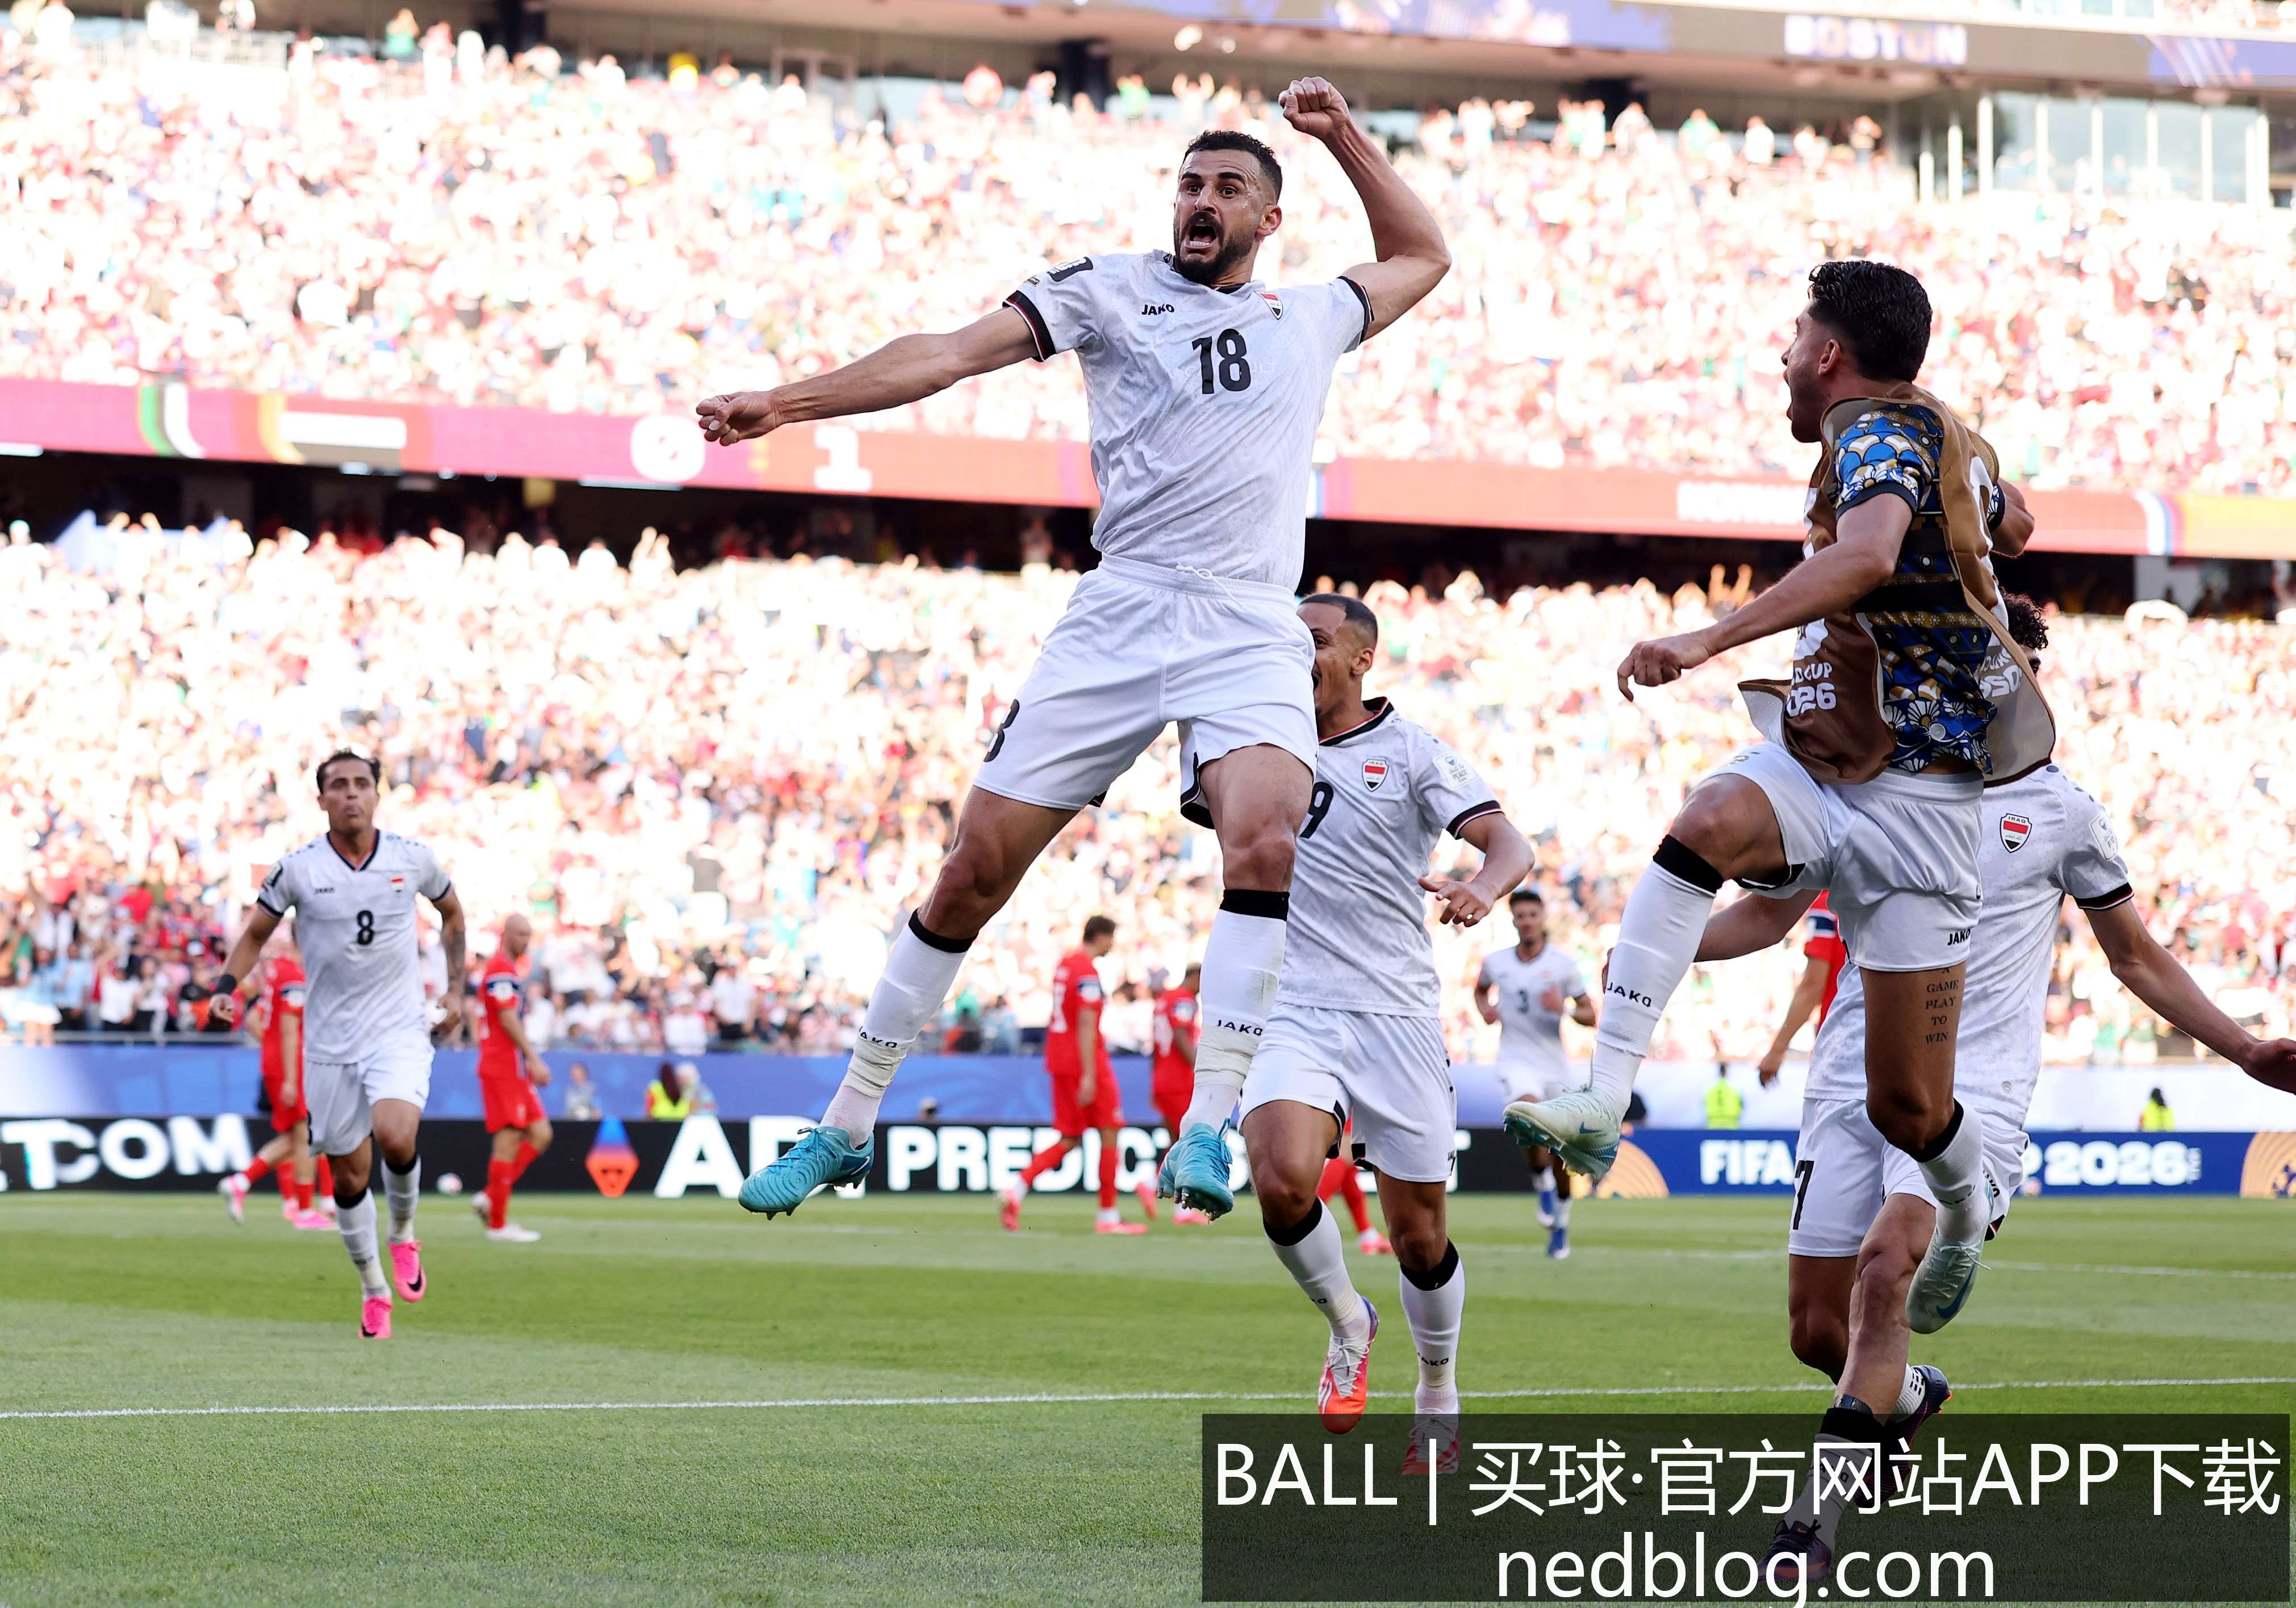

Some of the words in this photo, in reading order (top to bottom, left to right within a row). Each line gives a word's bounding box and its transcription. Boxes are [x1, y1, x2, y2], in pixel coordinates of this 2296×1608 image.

[1784, 14, 1968, 65] BOSTON
[1141, 304, 1174, 315] JAKO
[1191, 328, 1251, 395] 18
[814, 425, 873, 492] 1
[1804, 661, 1833, 681] CUP
[1787, 682, 1837, 717] 026
[1299, 782, 1334, 839] 9
[356, 910, 375, 945] 8
[1947, 928, 1971, 946] JAKO
[1607, 982, 1651, 1008] JAKO
[1926, 980, 1959, 993] GAME
[1926, 997, 1955, 1010] PLAY
[1217, 1020, 1263, 1036] JAKO
[1931, 1015, 1947, 1025] TO
[1926, 1032, 1948, 1044] WIN
[1700, 1139, 1795, 1186] FIFA
[2044, 1140, 2188, 1186] 2026
[1793, 1160, 1814, 1230] 7
